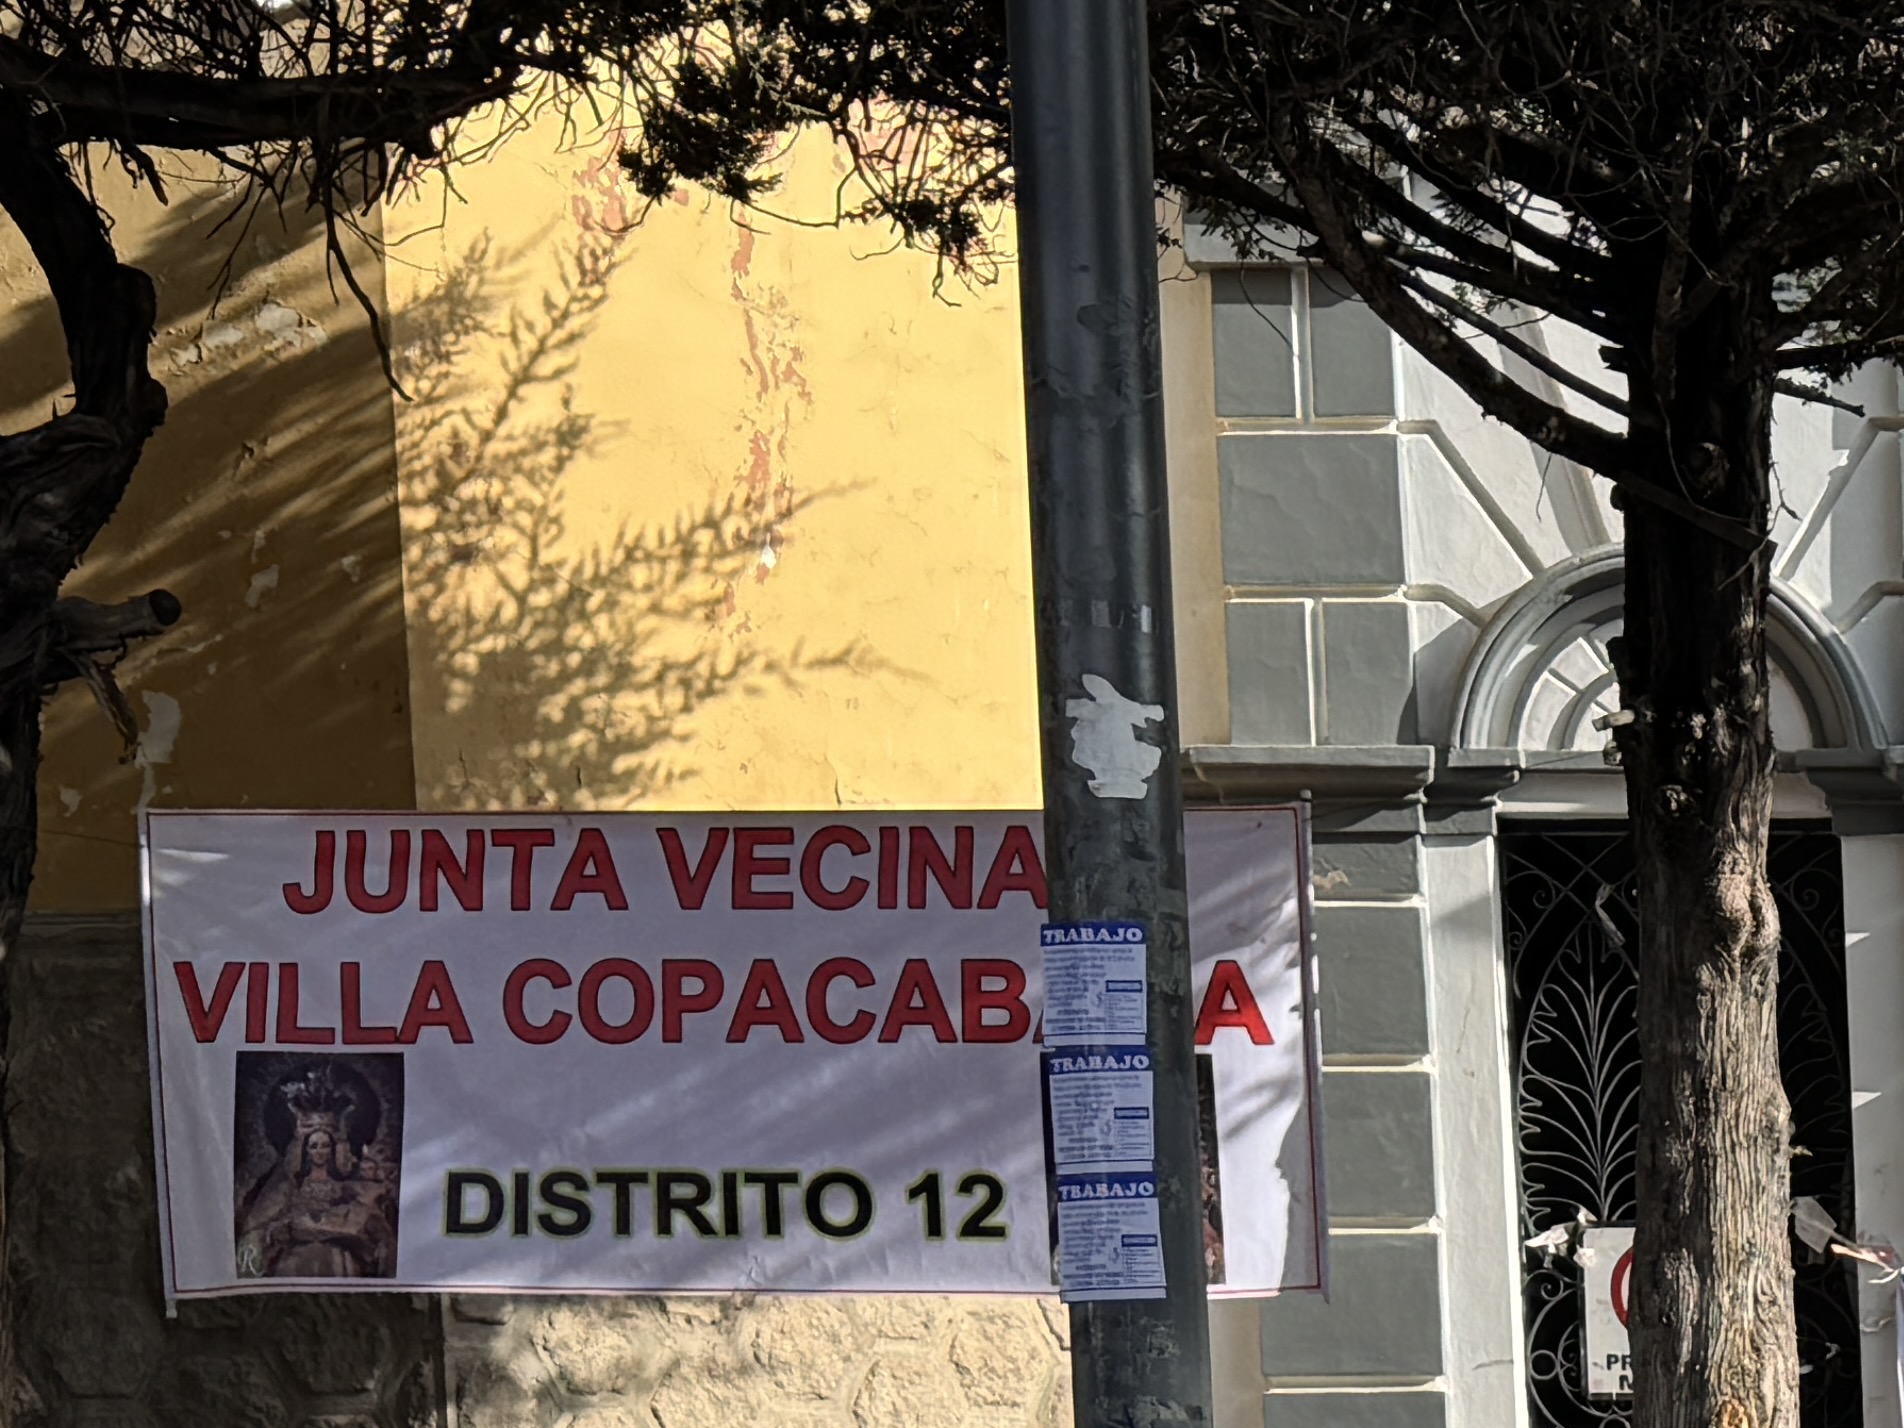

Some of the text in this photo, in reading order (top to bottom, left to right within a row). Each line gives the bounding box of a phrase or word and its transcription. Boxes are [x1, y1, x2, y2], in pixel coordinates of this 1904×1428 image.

[282, 823, 1047, 915] JUNTA VECINA
[1043, 927, 1143, 944] TRABAJO
[173, 957, 475, 1047] VILLA
[501, 956, 1275, 1047] COPACABA
[1050, 1054, 1150, 1072] TRABAJO
[439, 1168, 878, 1242] DISTRITO
[902, 1169, 1008, 1244] 12
[1058, 1181, 1154, 1200] TRABAJO
